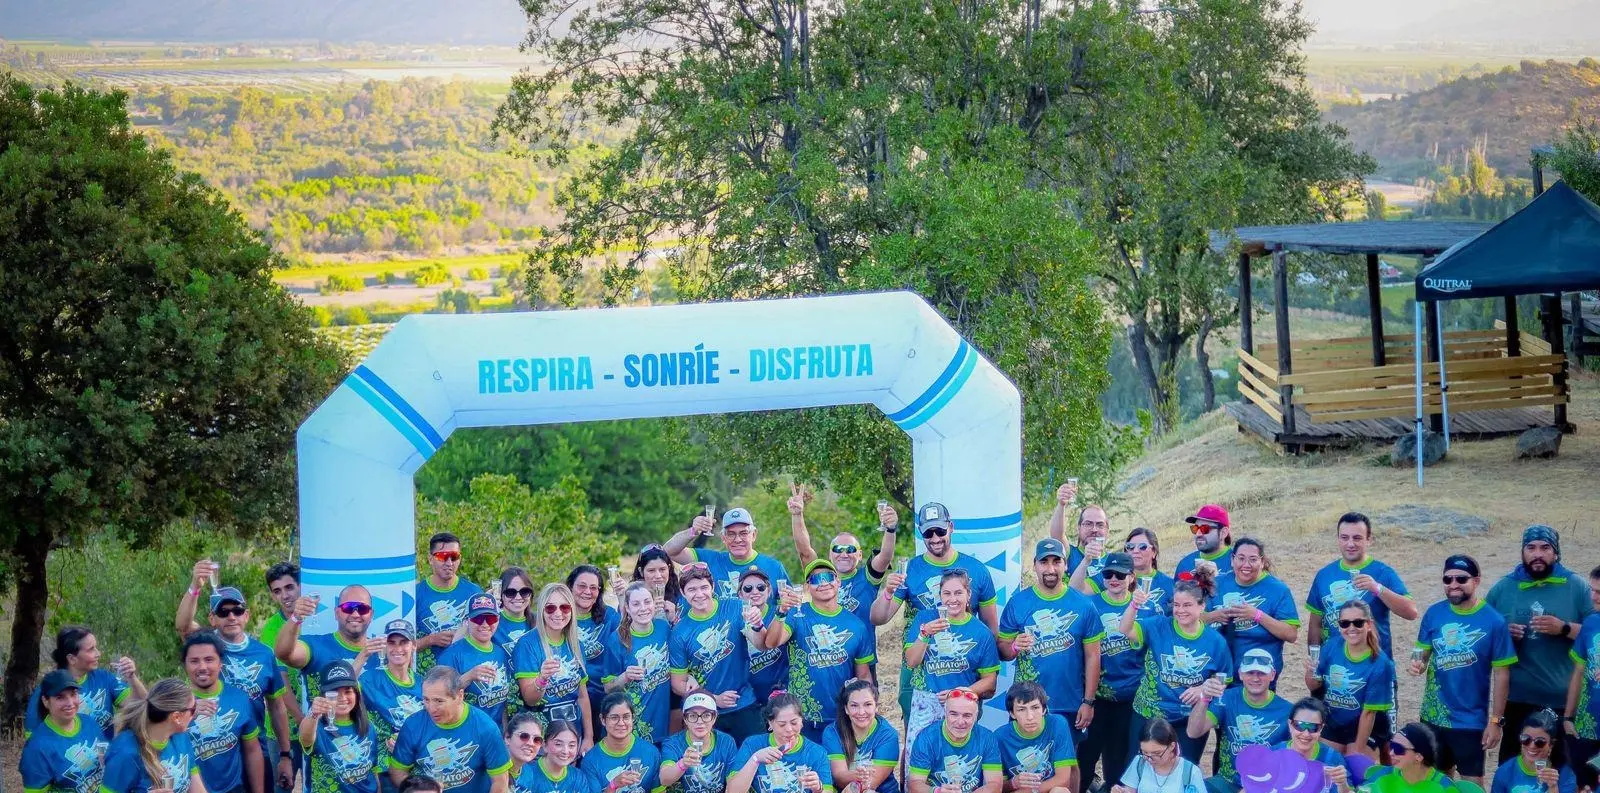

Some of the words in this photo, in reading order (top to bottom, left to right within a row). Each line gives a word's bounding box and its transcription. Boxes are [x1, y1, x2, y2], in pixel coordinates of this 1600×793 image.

[1424, 278, 1472, 292] QUITRAL
[478, 356, 594, 394] RESPIRA
[623, 343, 719, 388] SONRÍE
[749, 344, 873, 382] DISFRUTA
[749, 648, 780, 668] ARATOMA
[928, 657, 967, 672] MARATOMA
